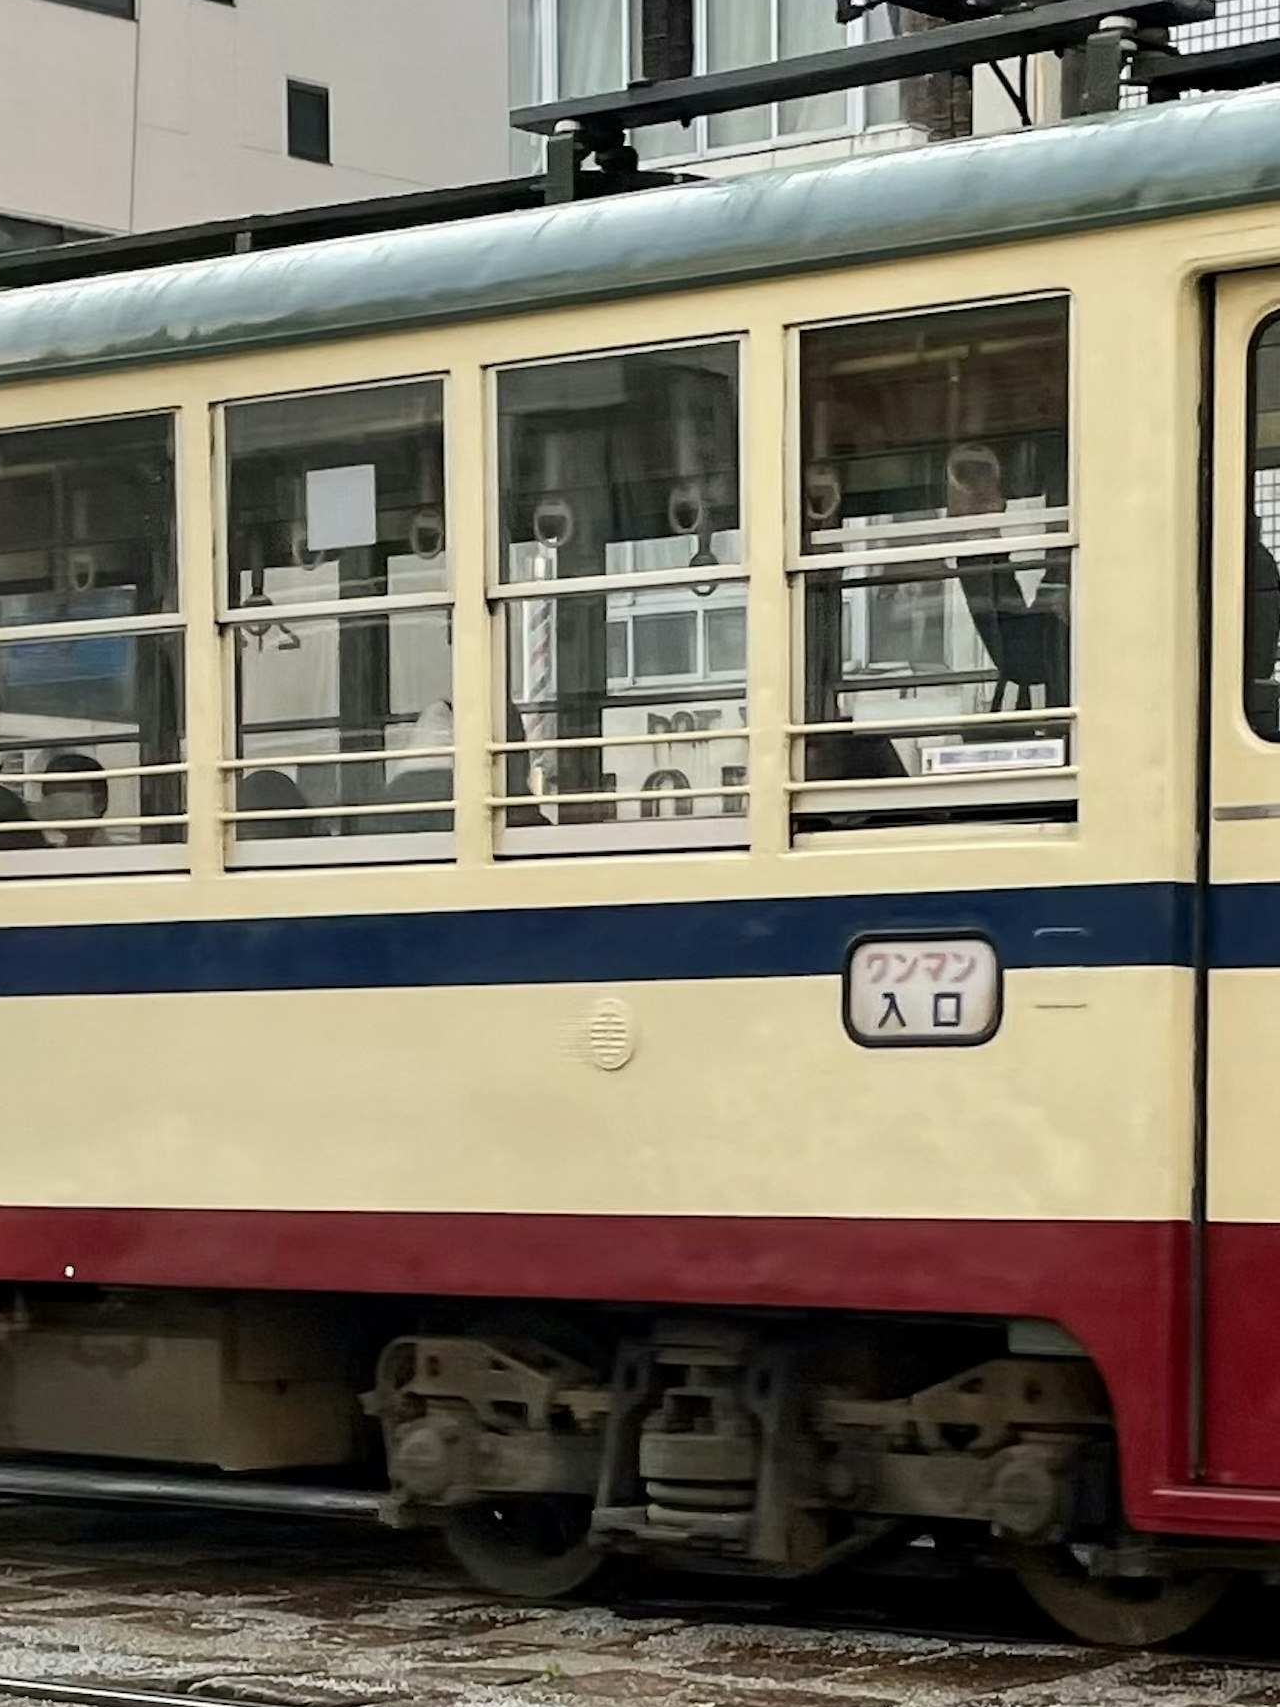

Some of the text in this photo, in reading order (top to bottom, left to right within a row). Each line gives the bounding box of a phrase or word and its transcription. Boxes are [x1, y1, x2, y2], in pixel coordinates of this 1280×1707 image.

[867, 952, 976, 984] ワンマン
[878, 991, 961, 1028] 入口
